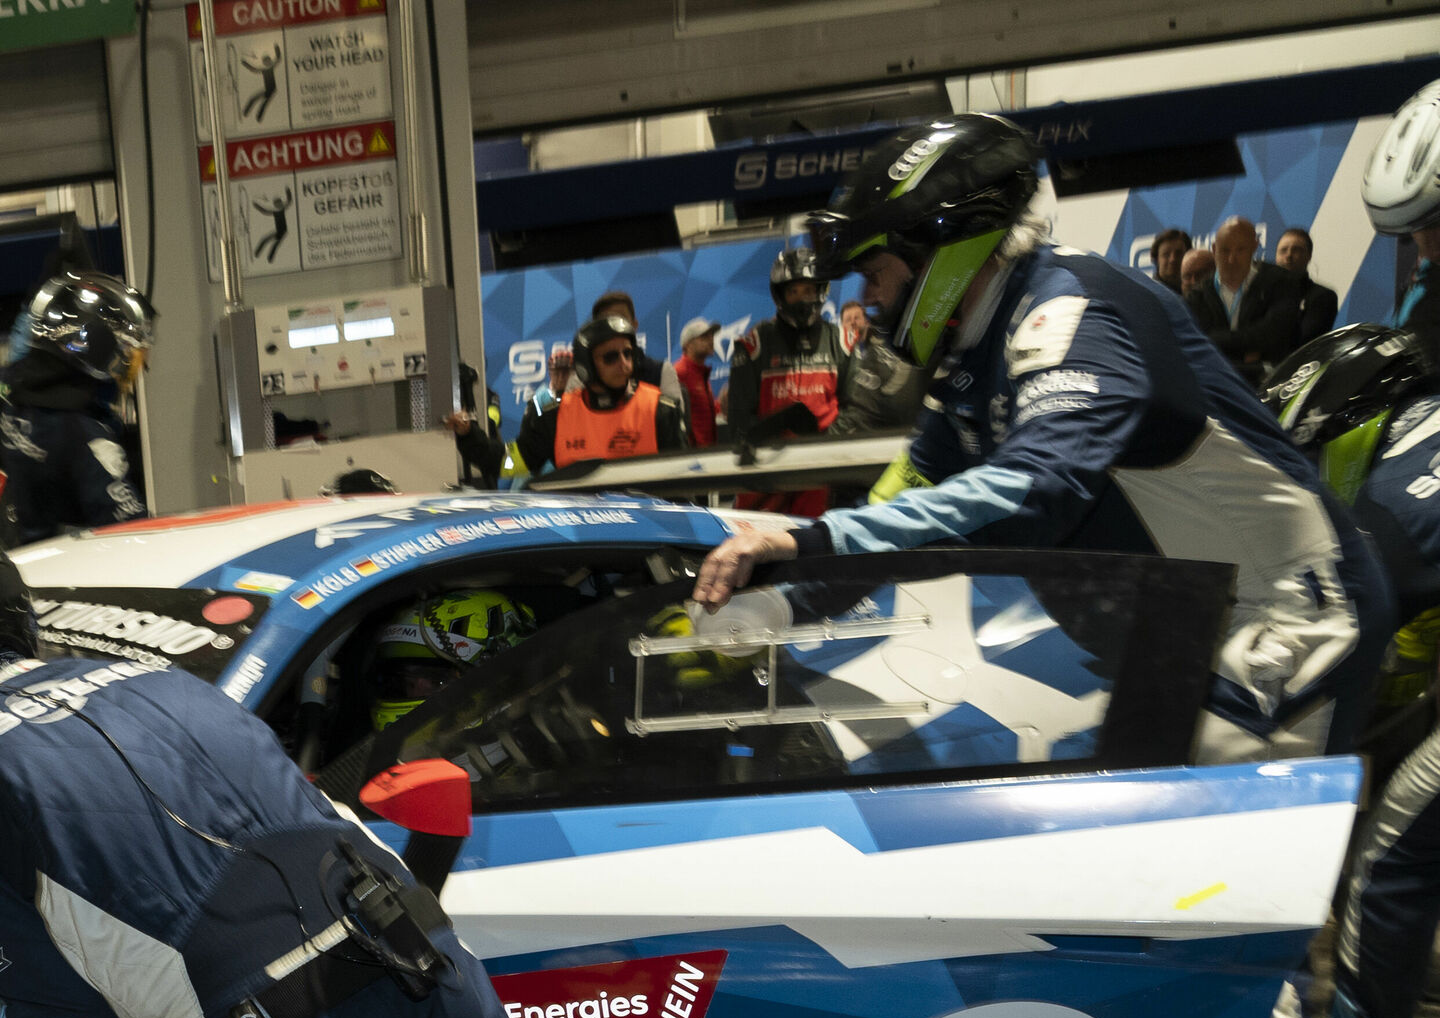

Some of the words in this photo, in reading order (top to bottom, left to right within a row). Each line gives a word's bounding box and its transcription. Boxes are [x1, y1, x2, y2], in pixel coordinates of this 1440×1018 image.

[232, 0, 342, 26] CAUTION
[292, 53, 337, 74] YOUR
[341, 48, 385, 68] HEAD
[233, 130, 364, 173] ACHTUNG
[314, 193, 384, 216] GEFAHR
